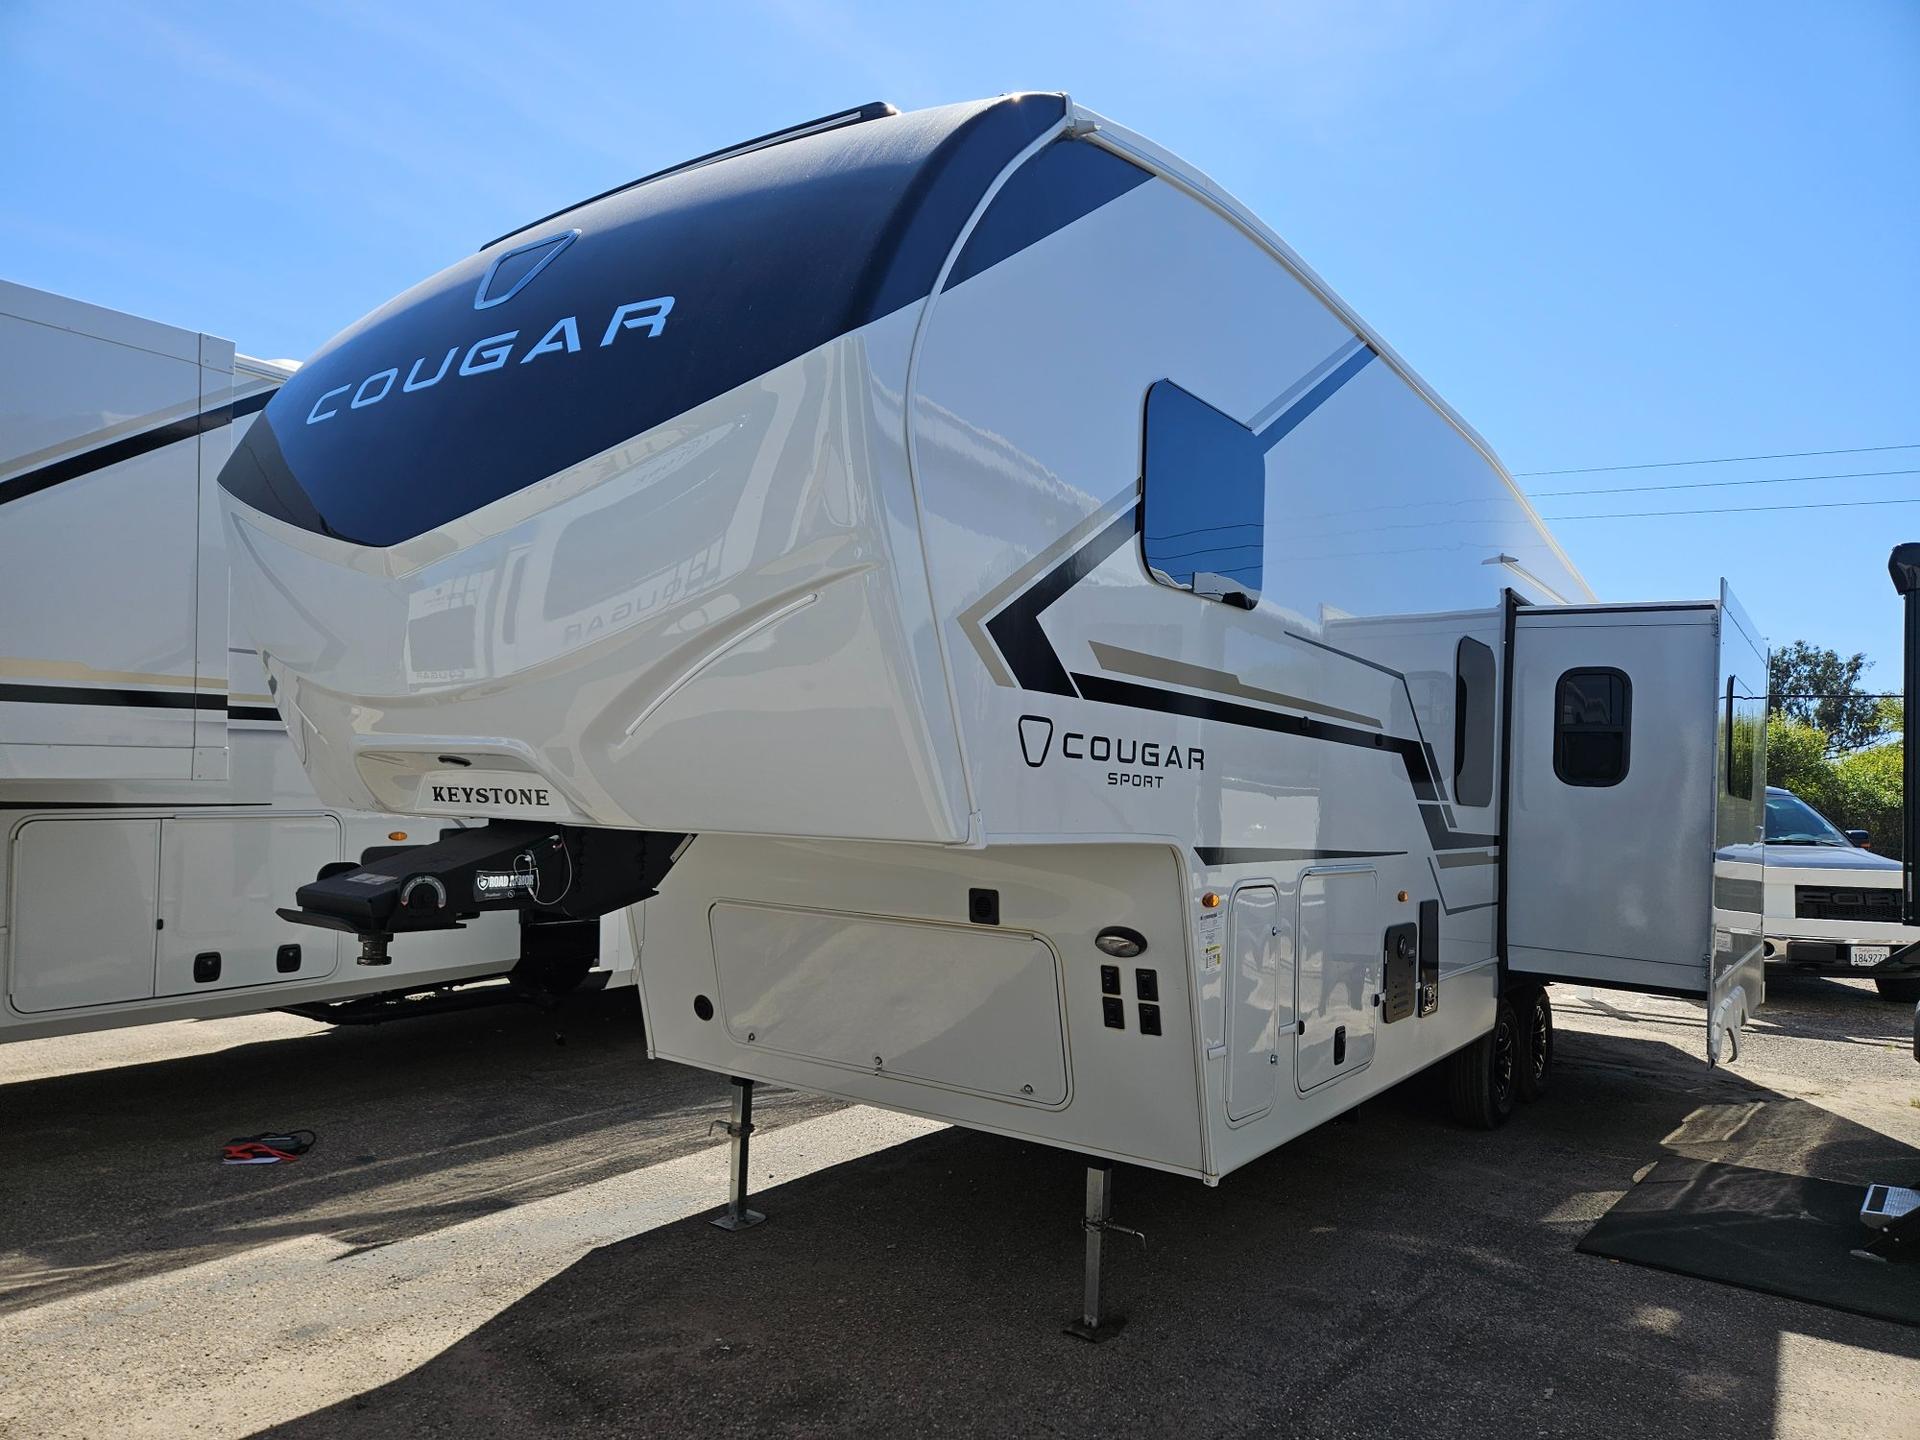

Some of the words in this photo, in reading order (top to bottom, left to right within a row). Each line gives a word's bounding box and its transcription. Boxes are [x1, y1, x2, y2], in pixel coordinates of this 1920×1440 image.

[306, 296, 675, 425] COUGAR
[1063, 733, 1205, 770] COUGAR
[1107, 773, 1164, 788] SPORT
[432, 786, 550, 806] KEYSTONE
[489, 876, 509, 888] ROAD
[1797, 892, 1902, 906] FOR
